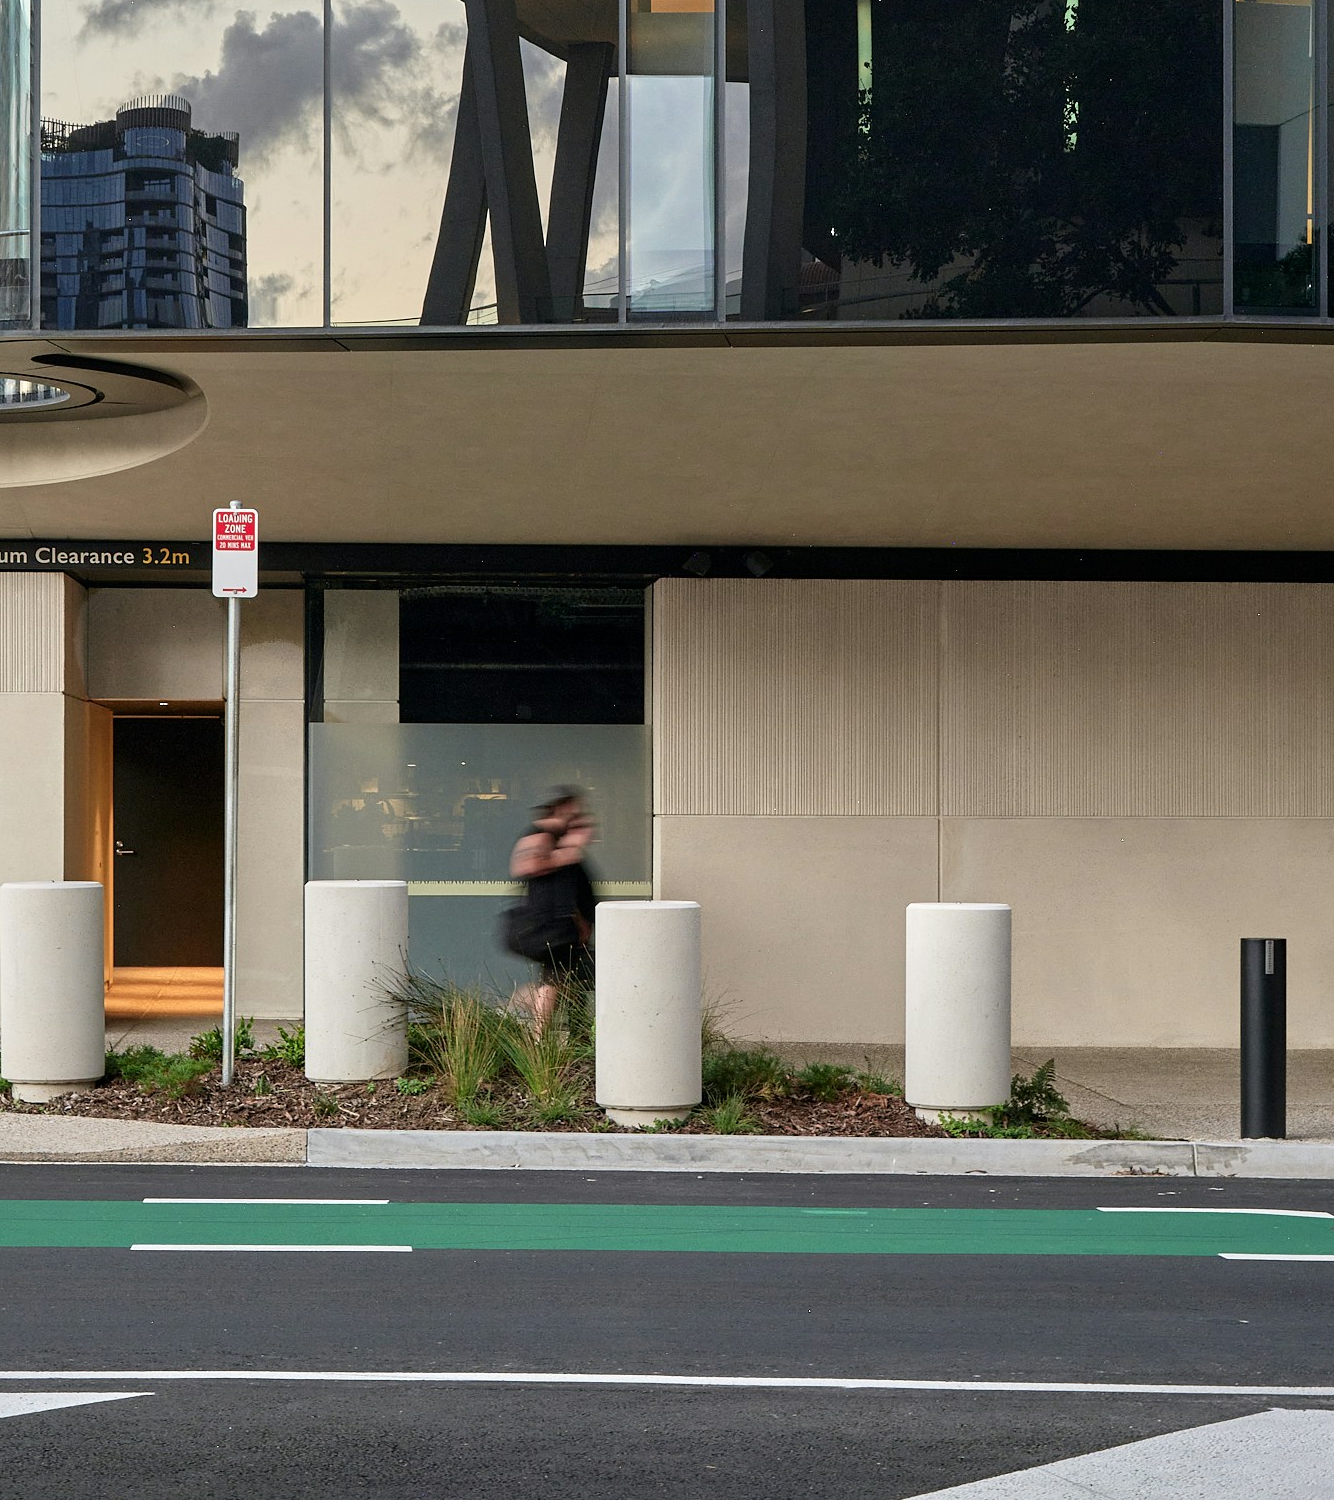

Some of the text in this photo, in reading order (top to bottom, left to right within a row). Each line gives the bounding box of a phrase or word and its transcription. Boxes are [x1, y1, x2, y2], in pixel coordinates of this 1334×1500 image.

[218, 514, 253, 523] LOADING
[224, 524, 246, 533] ZONE
[35, 547, 134, 565] Clearance
[142, 547, 190, 565] 3.2m
